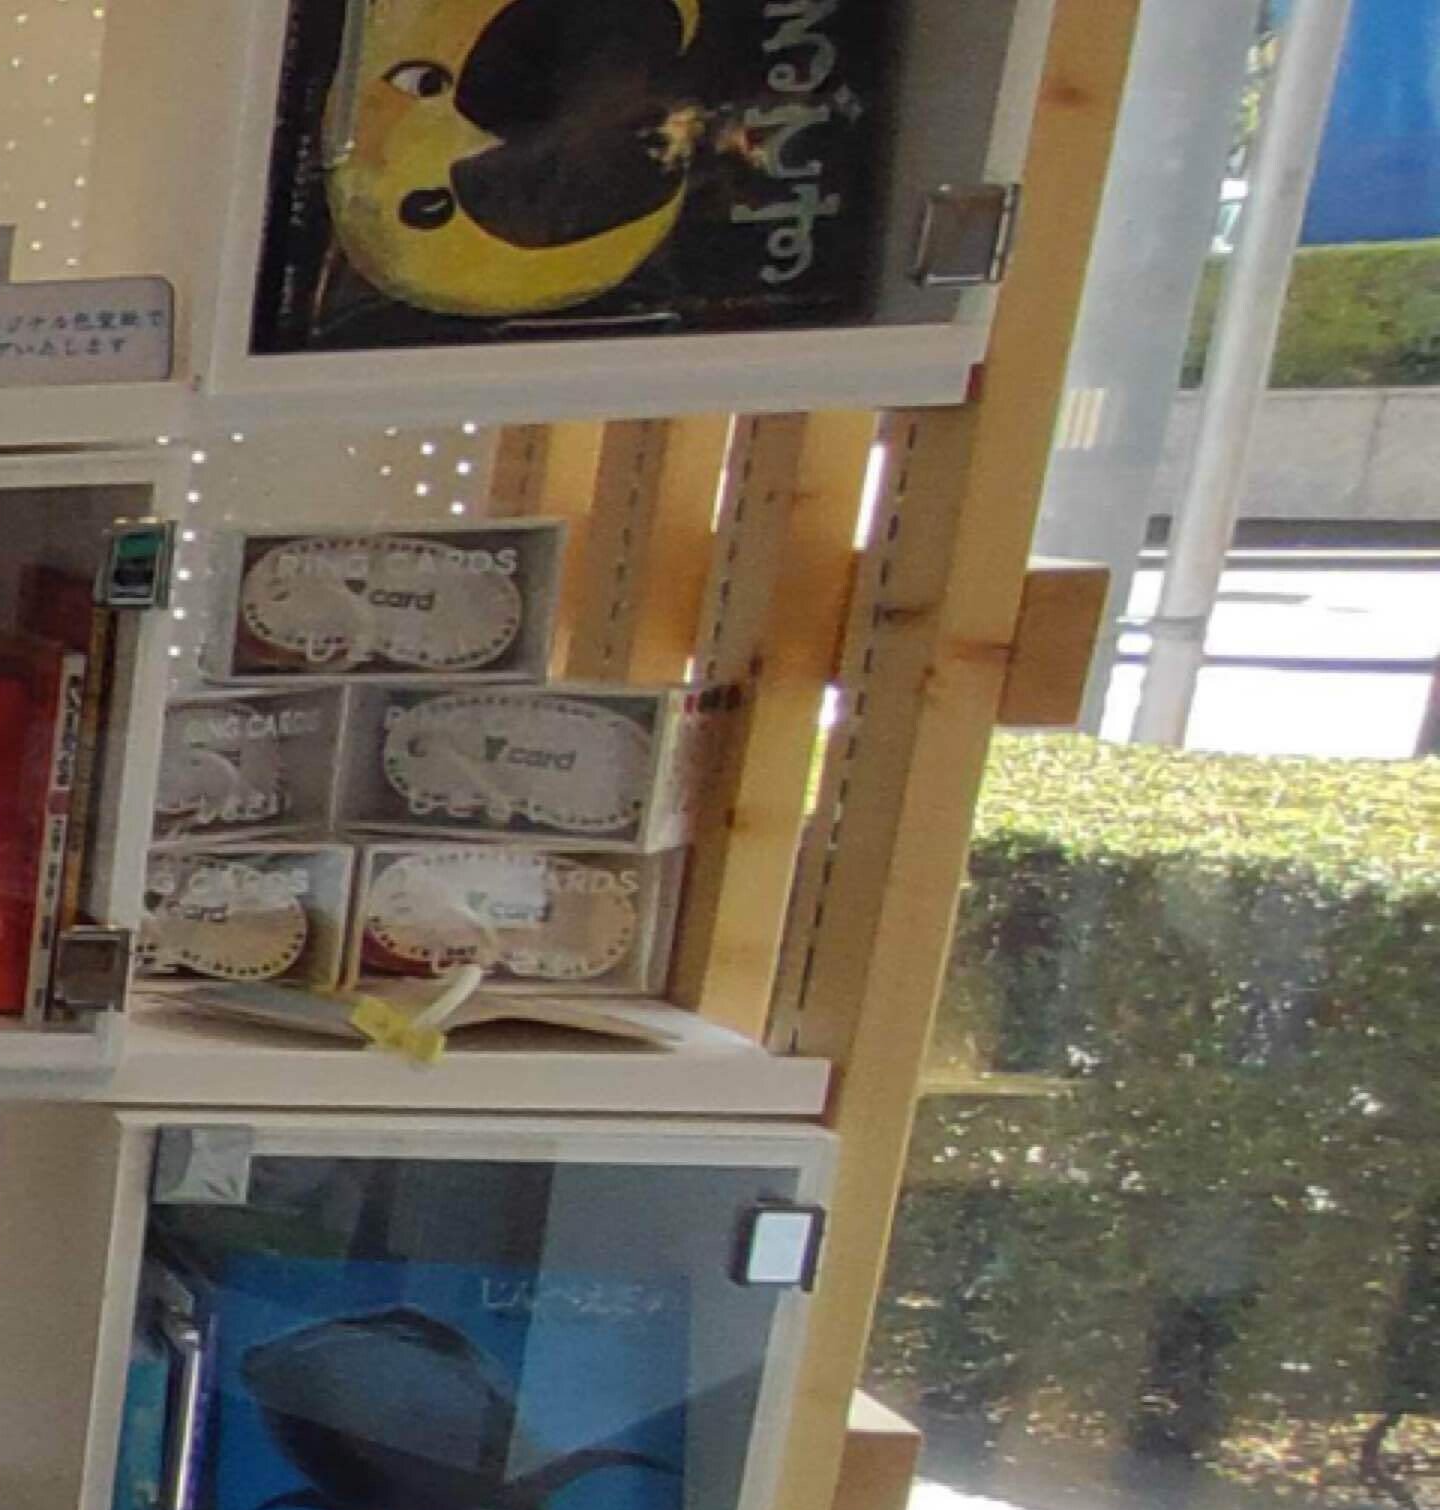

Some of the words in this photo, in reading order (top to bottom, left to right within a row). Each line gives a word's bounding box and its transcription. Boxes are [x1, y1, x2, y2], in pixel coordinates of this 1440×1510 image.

[730, 0, 863, 285] るです
[276, 553, 370, 577] RING
[369, 588, 436, 611] card
[508, 744, 578, 772] card
